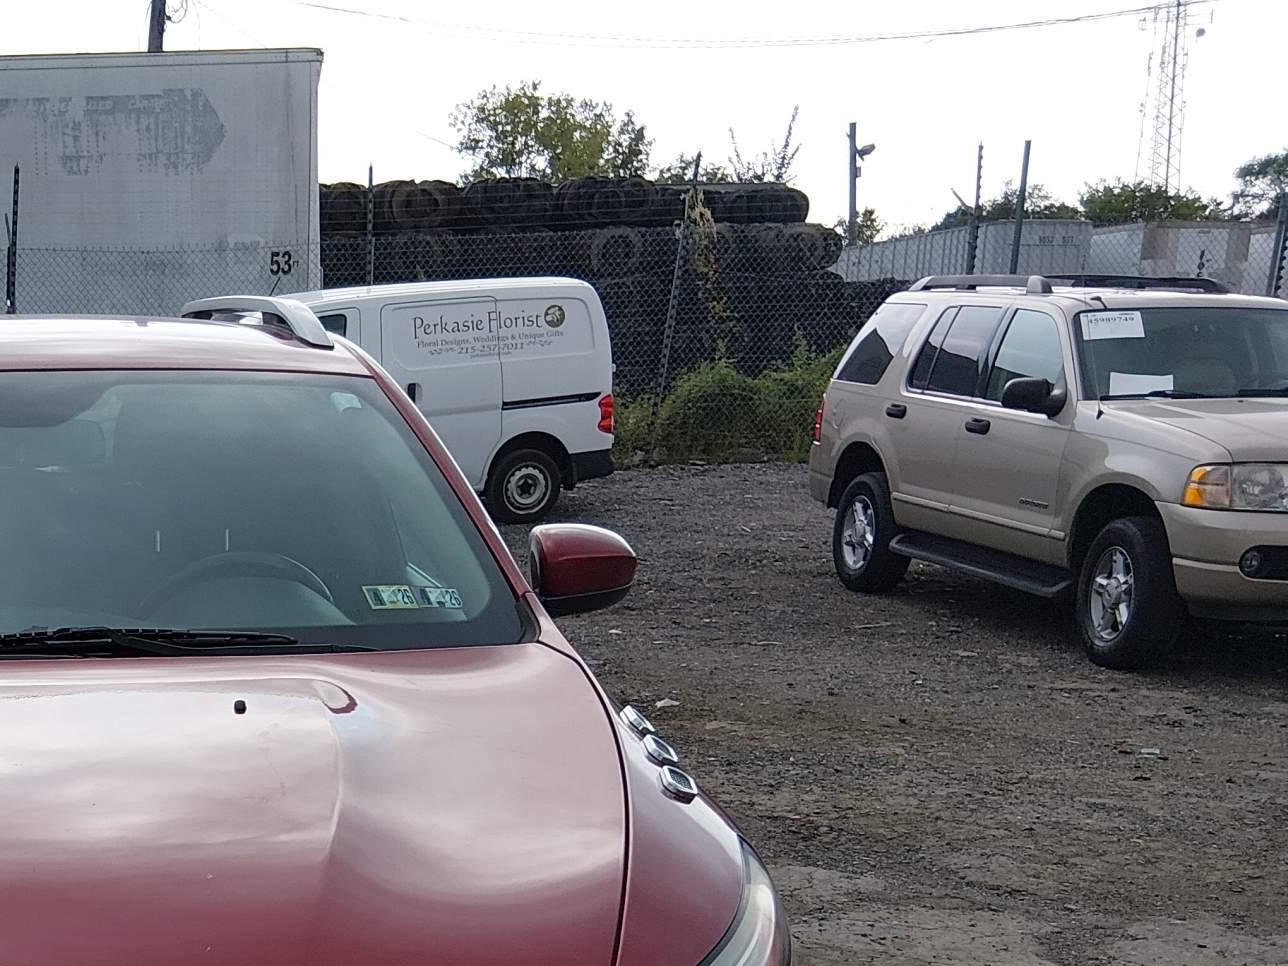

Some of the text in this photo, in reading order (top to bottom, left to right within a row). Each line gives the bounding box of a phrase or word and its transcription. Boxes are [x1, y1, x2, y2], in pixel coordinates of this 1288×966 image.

[270, 251, 292, 275] 53
[413, 309, 543, 339] Perkasie Florist
[417, 339, 439, 349] Floral
[473, 333, 509, 345] Weddings
[510, 333, 517, 341] &
[518, 331, 545, 341] Unique
[546, 329, 564, 338] Gifts
